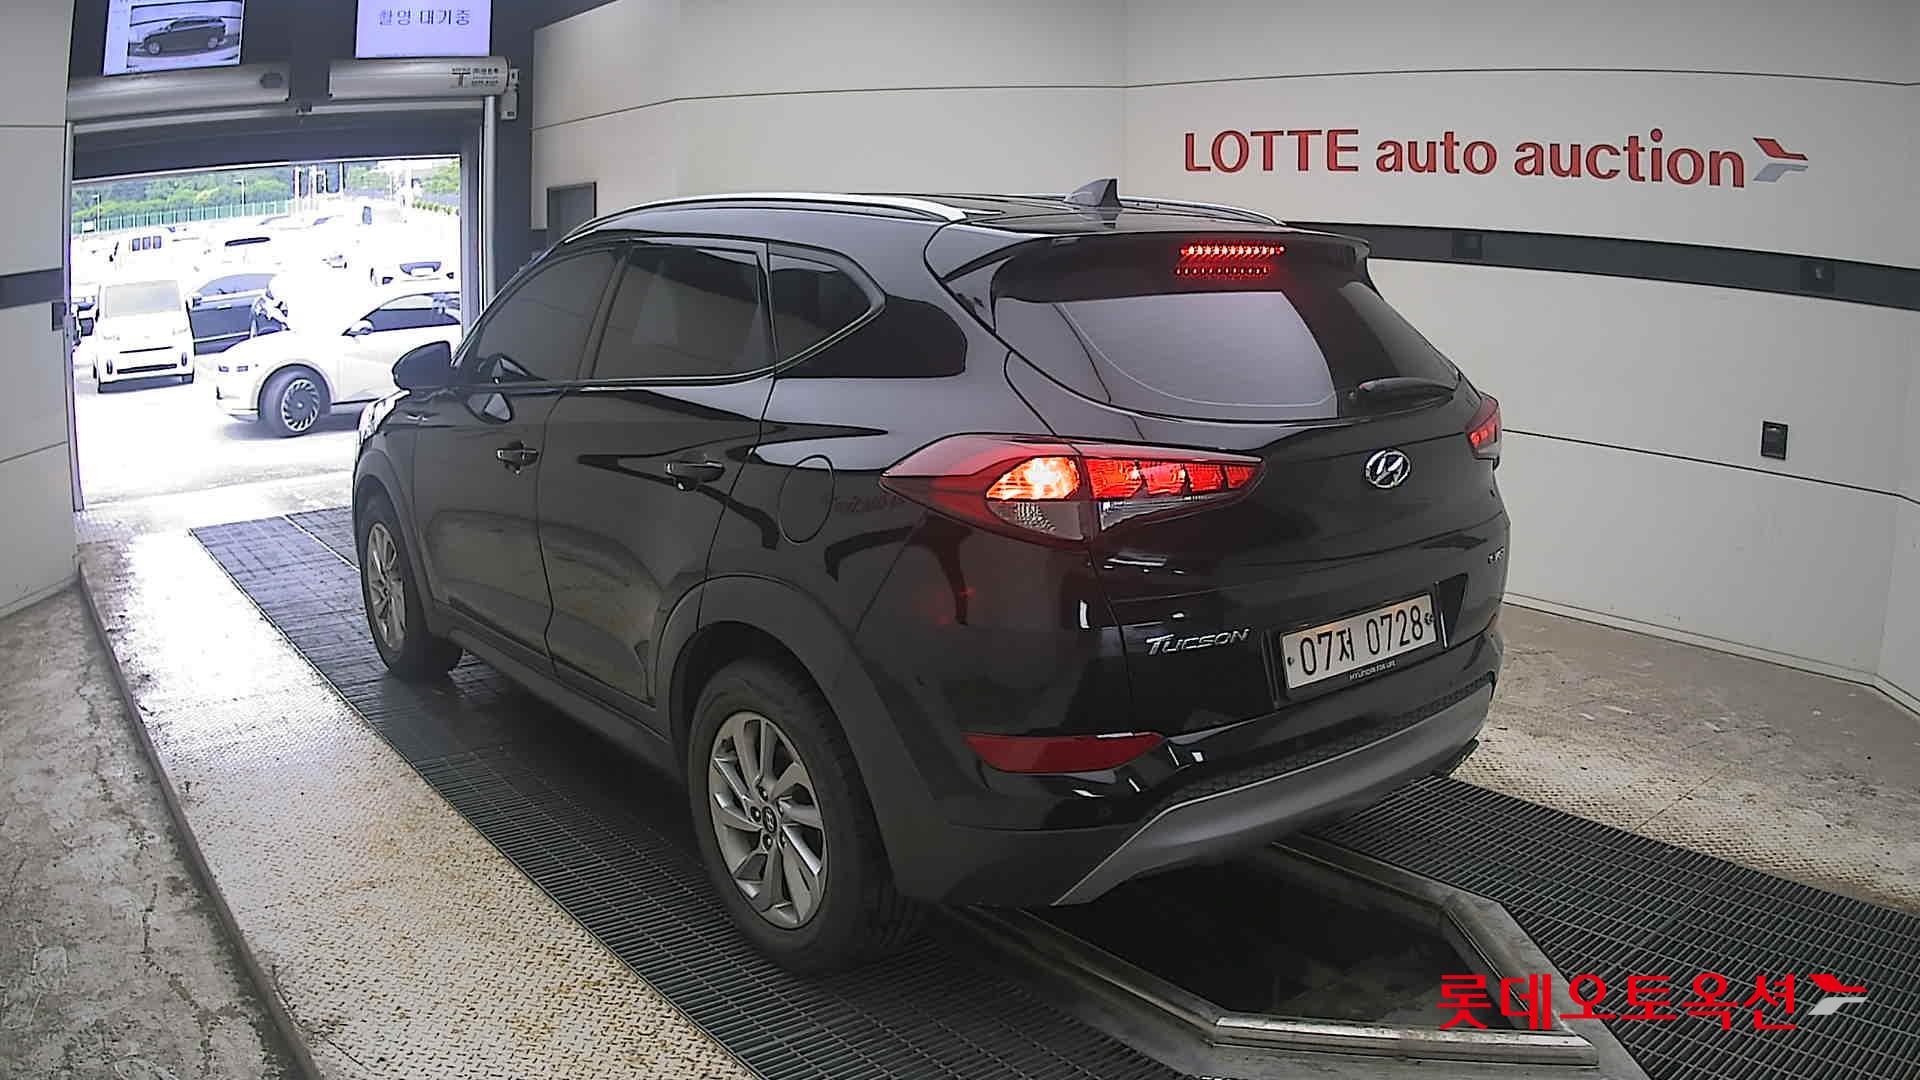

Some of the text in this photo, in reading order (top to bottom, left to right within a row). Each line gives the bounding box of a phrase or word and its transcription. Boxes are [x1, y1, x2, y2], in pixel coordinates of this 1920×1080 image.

[419, 9, 470, 25] 대기중
[1184, 128, 1745, 188] LOTTE auto auction
[1145, 628, 1250, 655] TUCSON
[1300, 605, 1424, 675] 07저 0728
